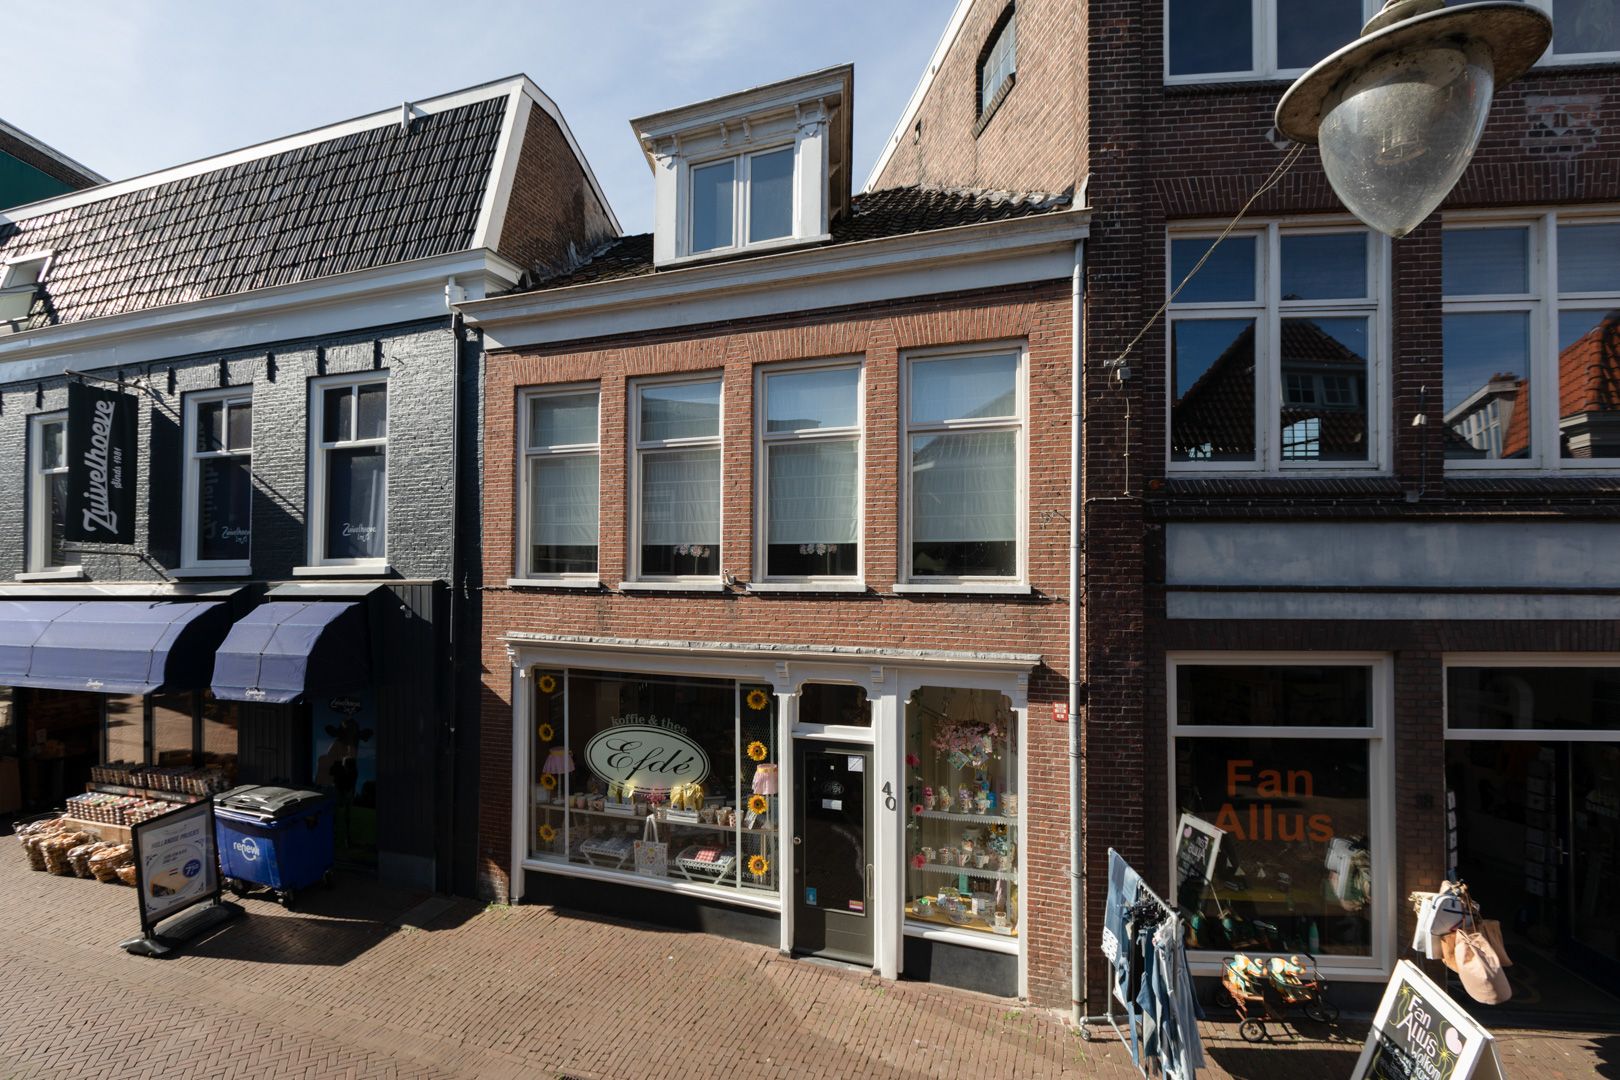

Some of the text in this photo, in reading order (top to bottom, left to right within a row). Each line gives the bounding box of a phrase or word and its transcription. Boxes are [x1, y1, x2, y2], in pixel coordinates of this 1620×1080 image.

[82, 400, 119, 535] Zuivelhoeve
[111, 447, 123, 489] Sinds 1981
[611, 713, 688, 735] koffie & thee
[605, 738, 695, 781] Efdé
[1226, 759, 1313, 799] Fan
[881, 781, 897, 812] 40
[1215, 803, 1335, 843] Allus
[1408, 994, 1432, 1030] Fan
